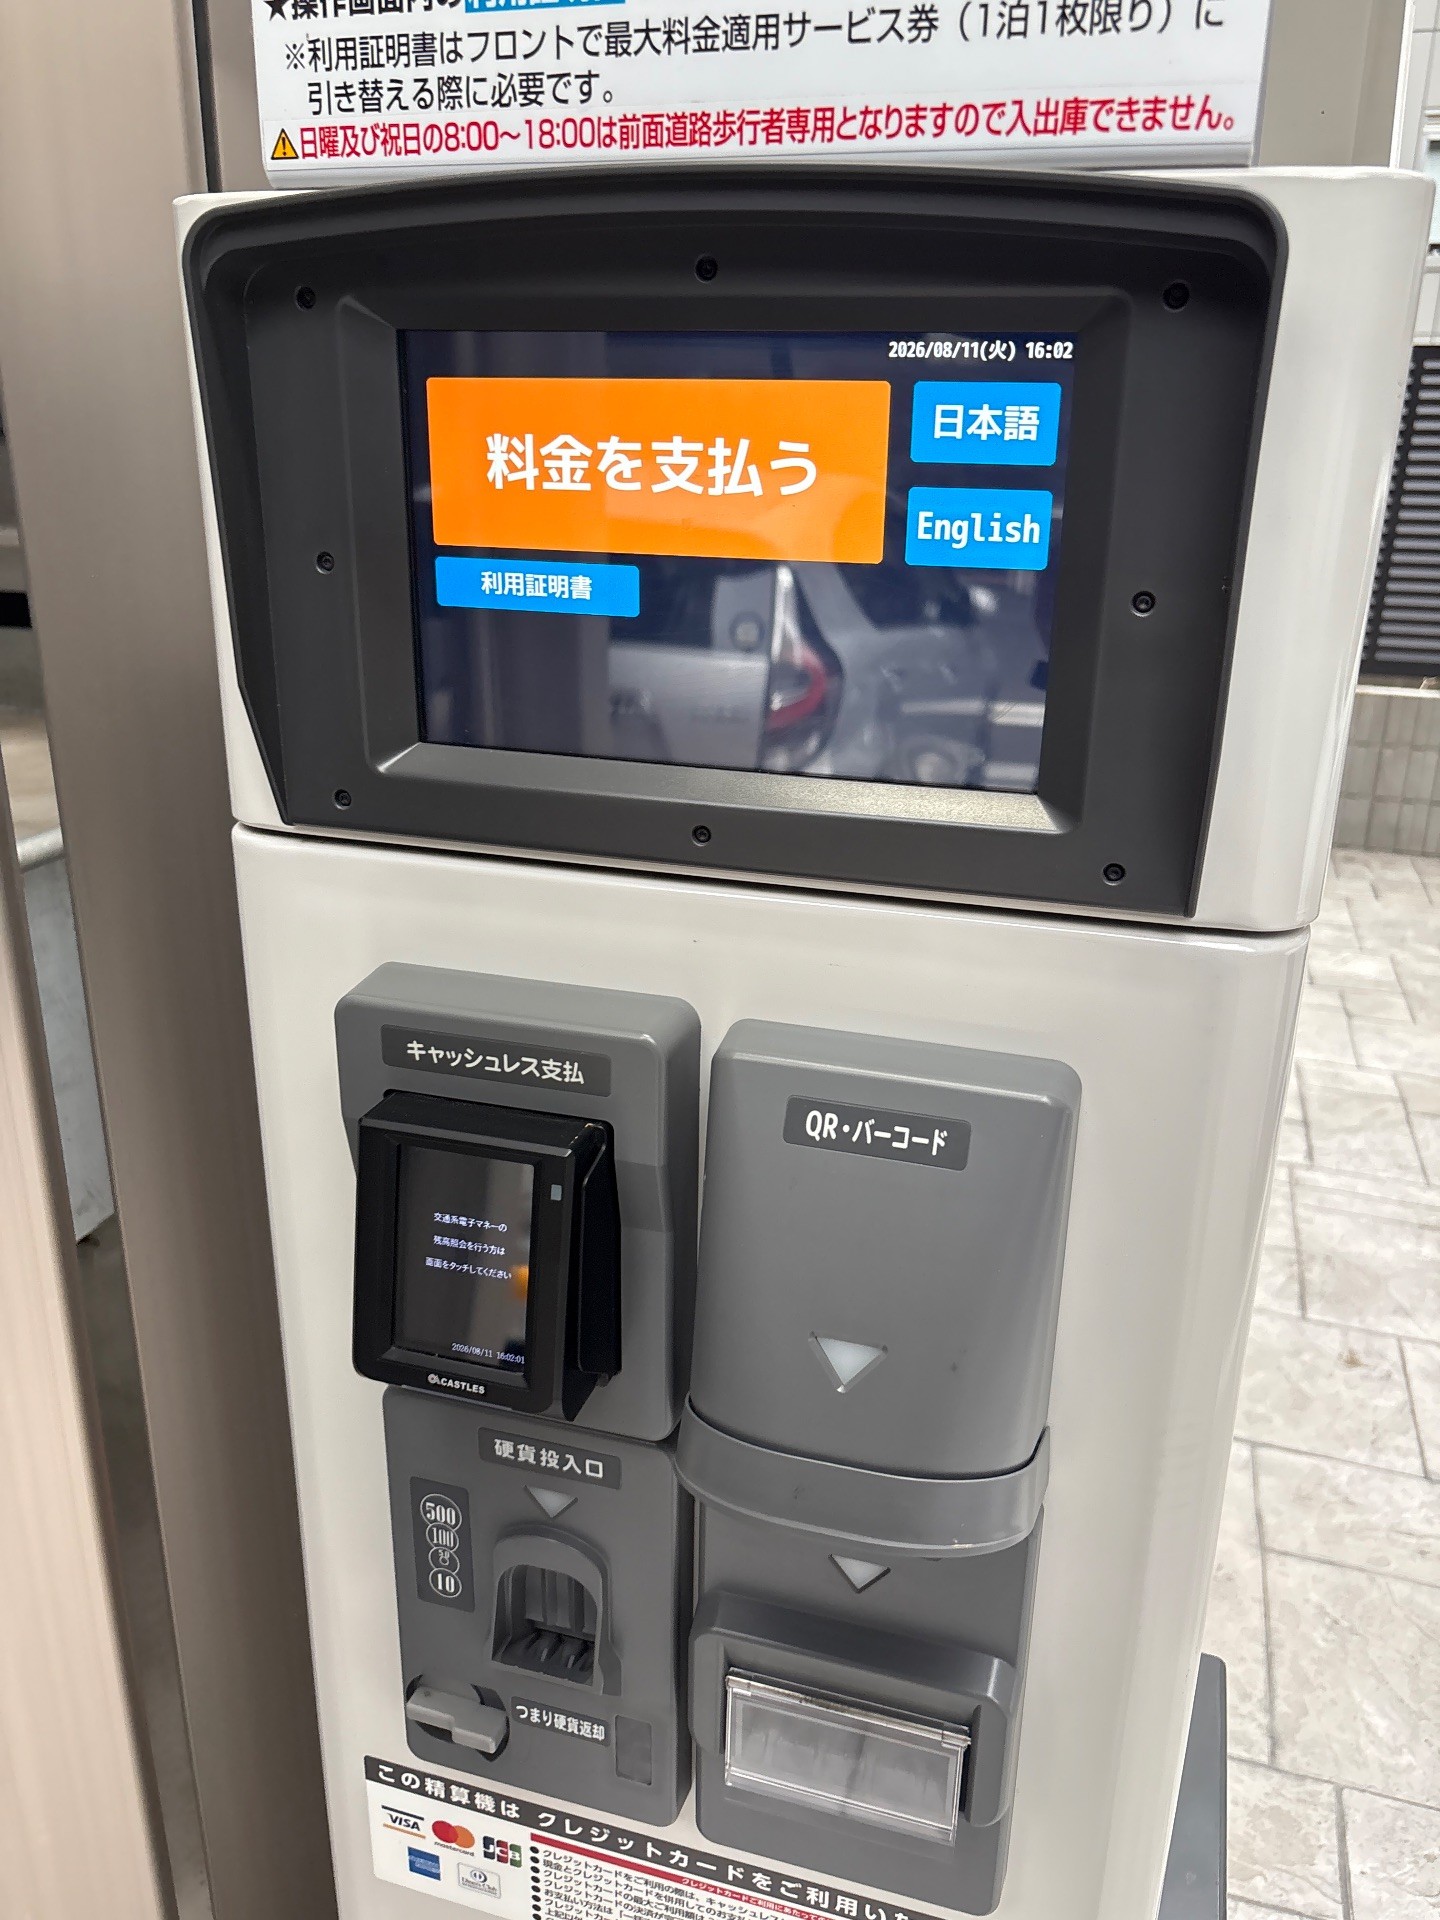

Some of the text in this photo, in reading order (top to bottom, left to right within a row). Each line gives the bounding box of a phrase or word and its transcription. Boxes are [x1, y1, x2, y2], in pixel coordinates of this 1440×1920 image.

[307, 70, 612, 116] 引き替える際に必要です。
[888, 340, 1075, 362] 2026/08/11(火) 16:02
[933, 404, 1040, 442] 日本語
[486, 433, 818, 497] 料金を支払う
[917, 511, 1041, 548] English
[480, 570, 593, 600] 利用証明書
[406, 1040, 585, 1084] キャッシュレス支払
[805, 1110, 948, 1156] QR・バーコード
[433, 1212, 508, 1232] 交通系電子マネーの
[432, 1235, 506, 1256] 残高照会を行う方は
[425, 1256, 512, 1279] 画面をタッチしてください
[440, 1377, 486, 1395] CASTLES
[493, 1438, 604, 1479] 硬貨投入口
[425, 1501, 456, 1527] 500
[432, 1527, 455, 1548] 100
[436, 1573, 456, 1594] 10
[516, 1705, 606, 1741] つまり硬貨返却
[378, 1763, 521, 1819] この精算機は
[388, 1813, 421, 1831] VISA
[483, 1839, 521, 1865] JCB
